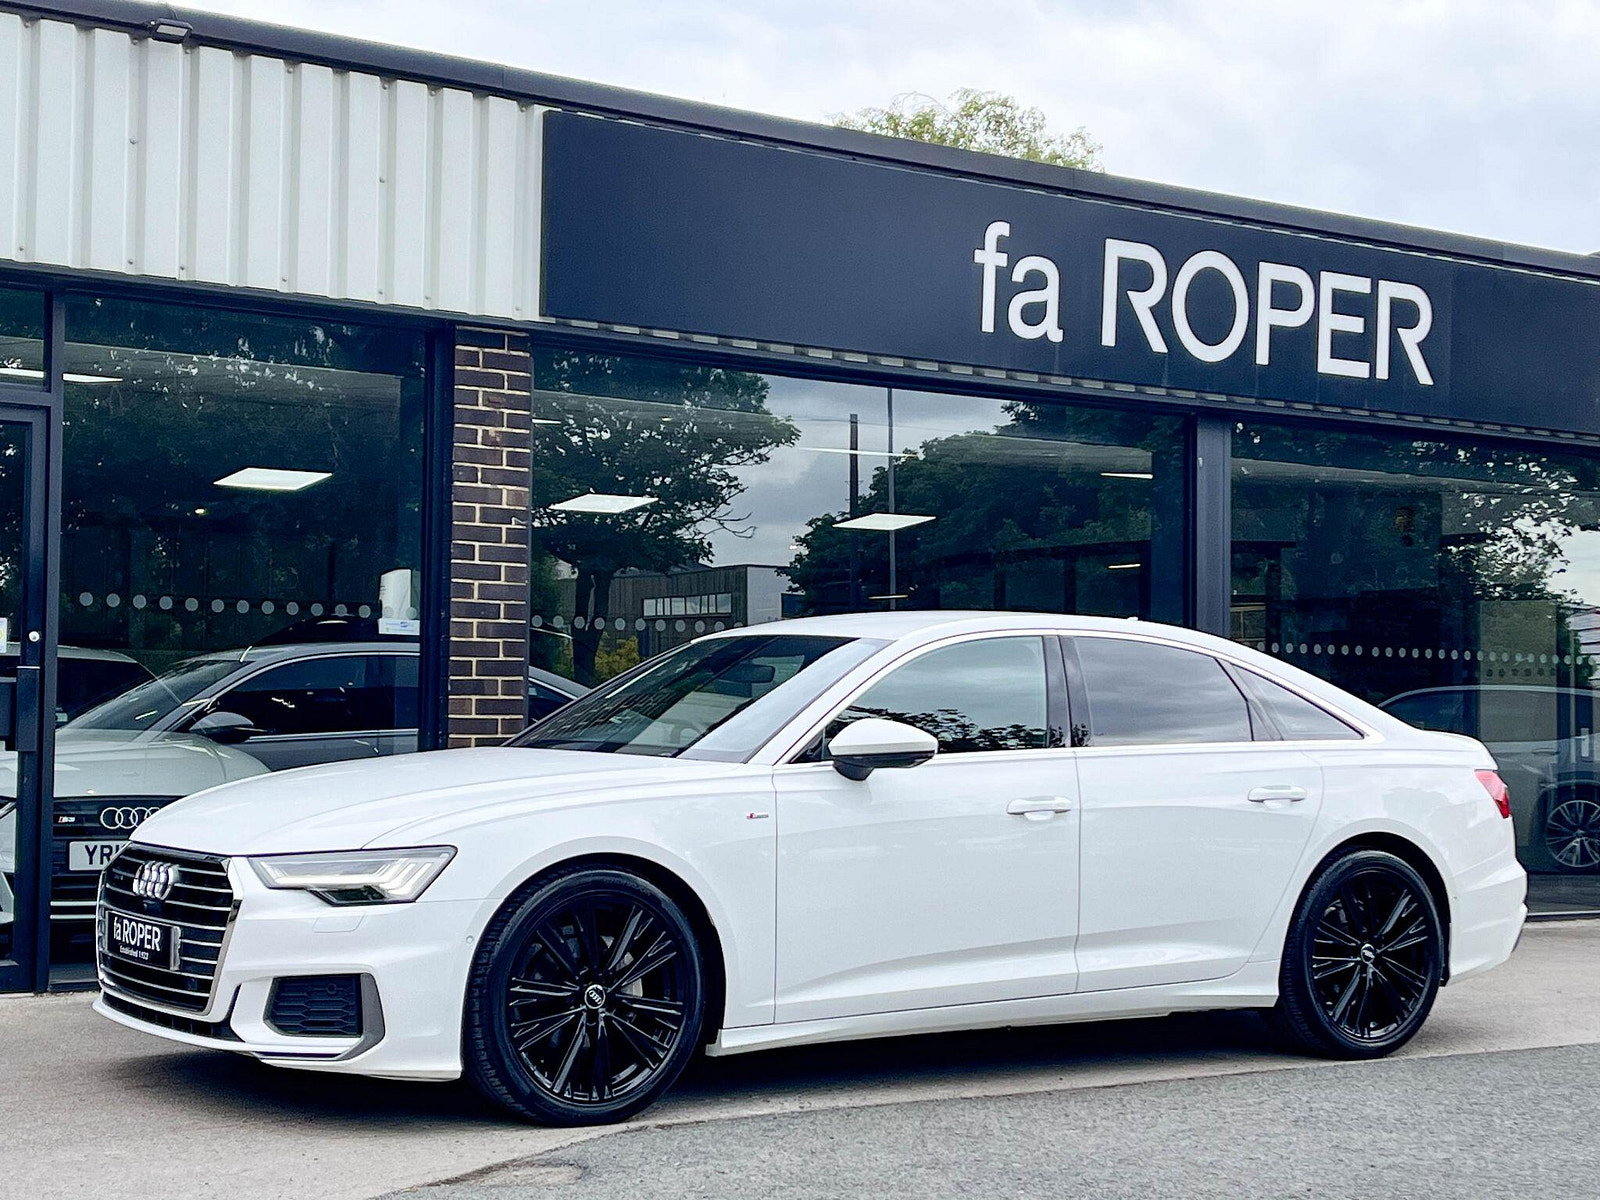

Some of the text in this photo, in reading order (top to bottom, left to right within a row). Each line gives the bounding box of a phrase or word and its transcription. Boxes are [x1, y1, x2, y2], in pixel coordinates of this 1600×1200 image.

[974, 220, 1434, 385] fa ROPER
[123, 919, 160, 951] ROPER
